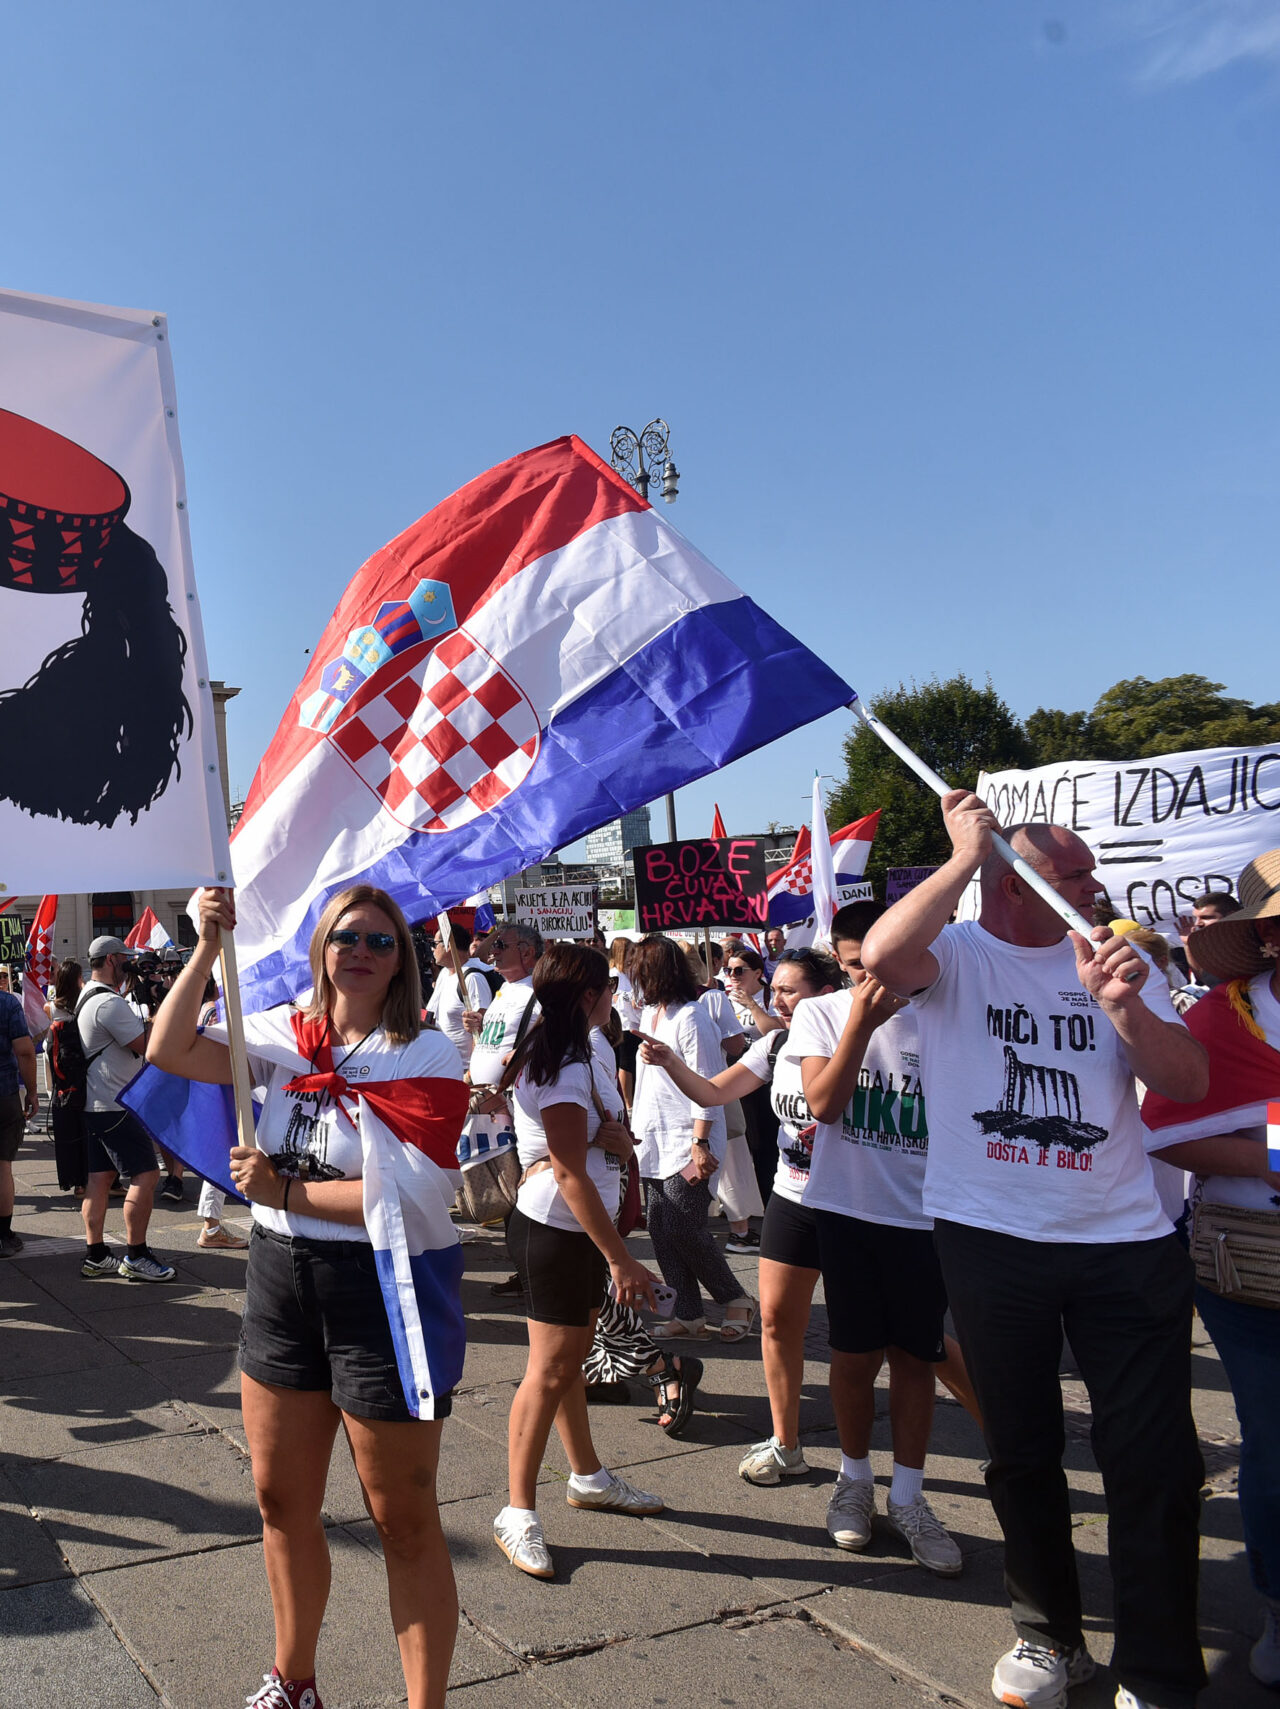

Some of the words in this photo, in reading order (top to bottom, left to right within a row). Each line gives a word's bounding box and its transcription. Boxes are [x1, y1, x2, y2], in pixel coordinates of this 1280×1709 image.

[515, 893, 547, 907] VRIJEME
[838, 885, 872, 901] DANI
[642, 891, 769, 931] HRVATSKU
[987, 1003, 1038, 1045] MIČI
[1049, 1014, 1096, 1051] TO!
[860, 1068, 894, 1095] DAJ
[987, 1141, 1029, 1164] DOSTA
[1037, 1148, 1049, 1166] JE
[1057, 1150, 1093, 1172] BILO!
